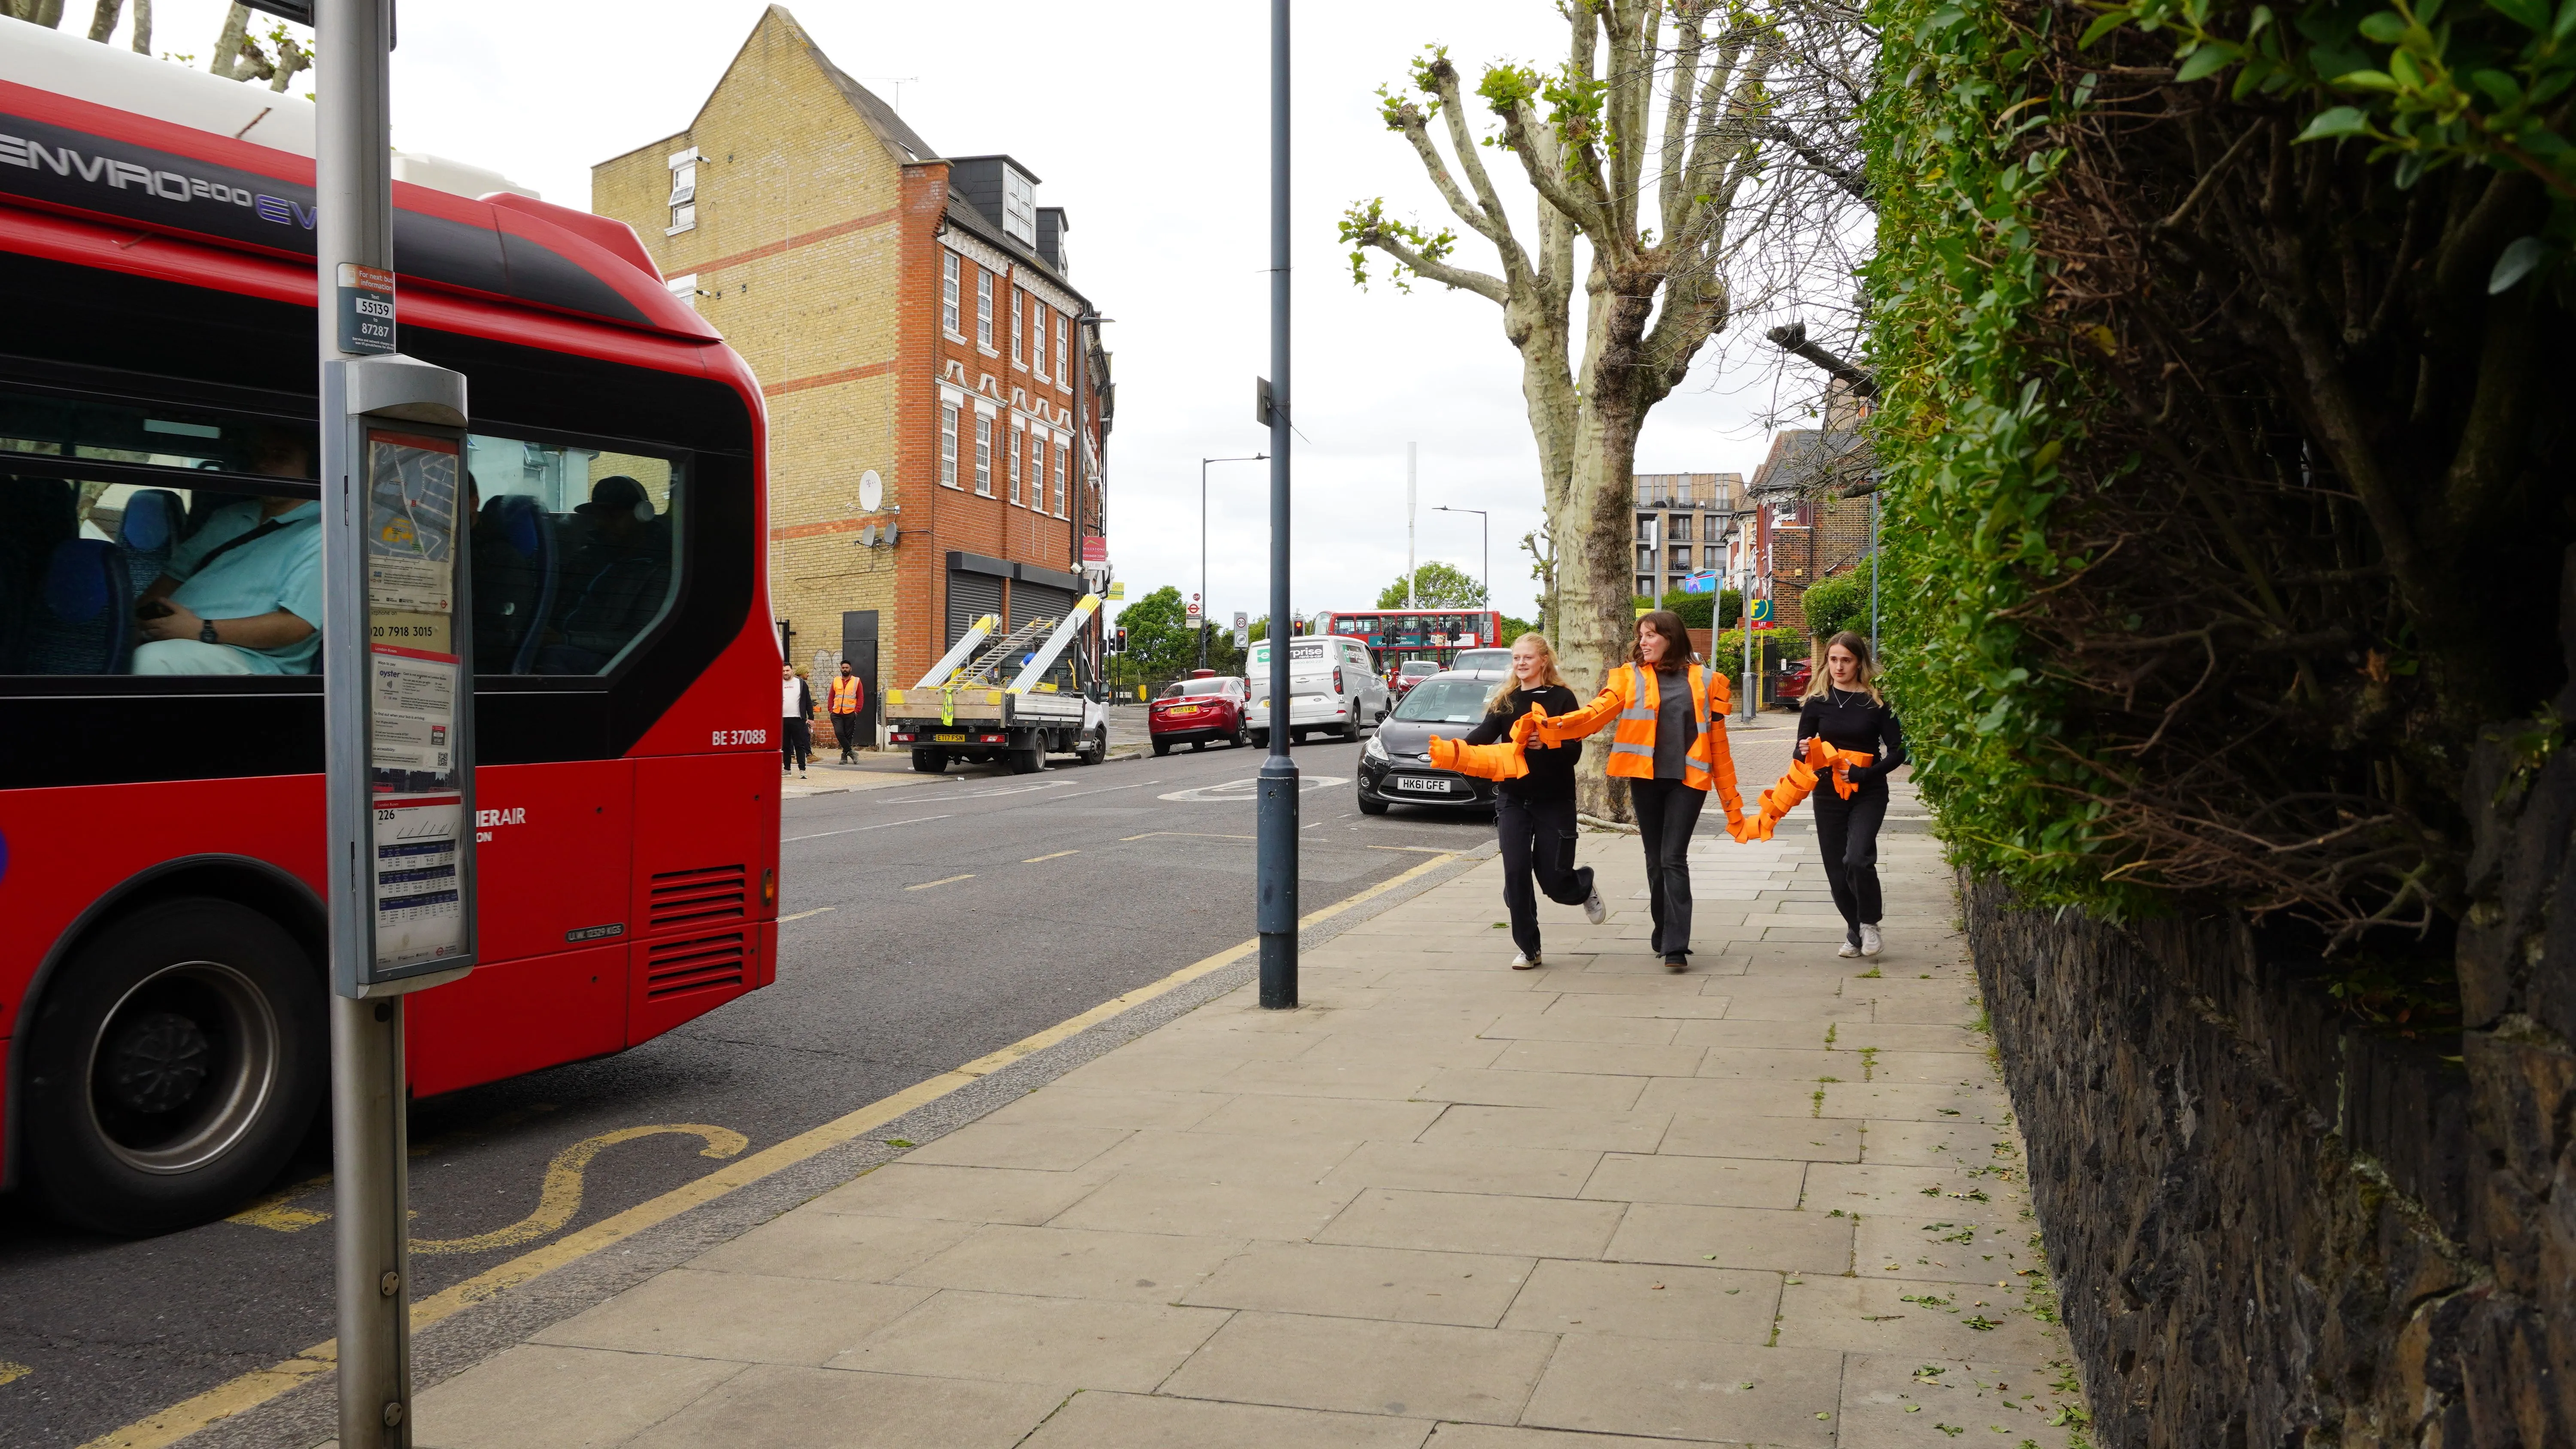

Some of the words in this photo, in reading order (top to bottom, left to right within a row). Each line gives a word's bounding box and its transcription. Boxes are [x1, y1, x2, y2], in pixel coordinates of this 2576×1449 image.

[361, 279, 392, 291] information
[361, 301, 389, 315] 55139
[361, 322, 389, 337] 87287
[388, 627, 409, 637] 7918
[413, 627, 432, 637] 3015
[380, 670, 401, 678] oyster
[712, 731, 728, 746] BE
[730, 729, 766, 745] 37088
[1403, 779, 1424, 789] HK61
[1426, 781, 1445, 790] GFE
[378, 809, 395, 820] 226
